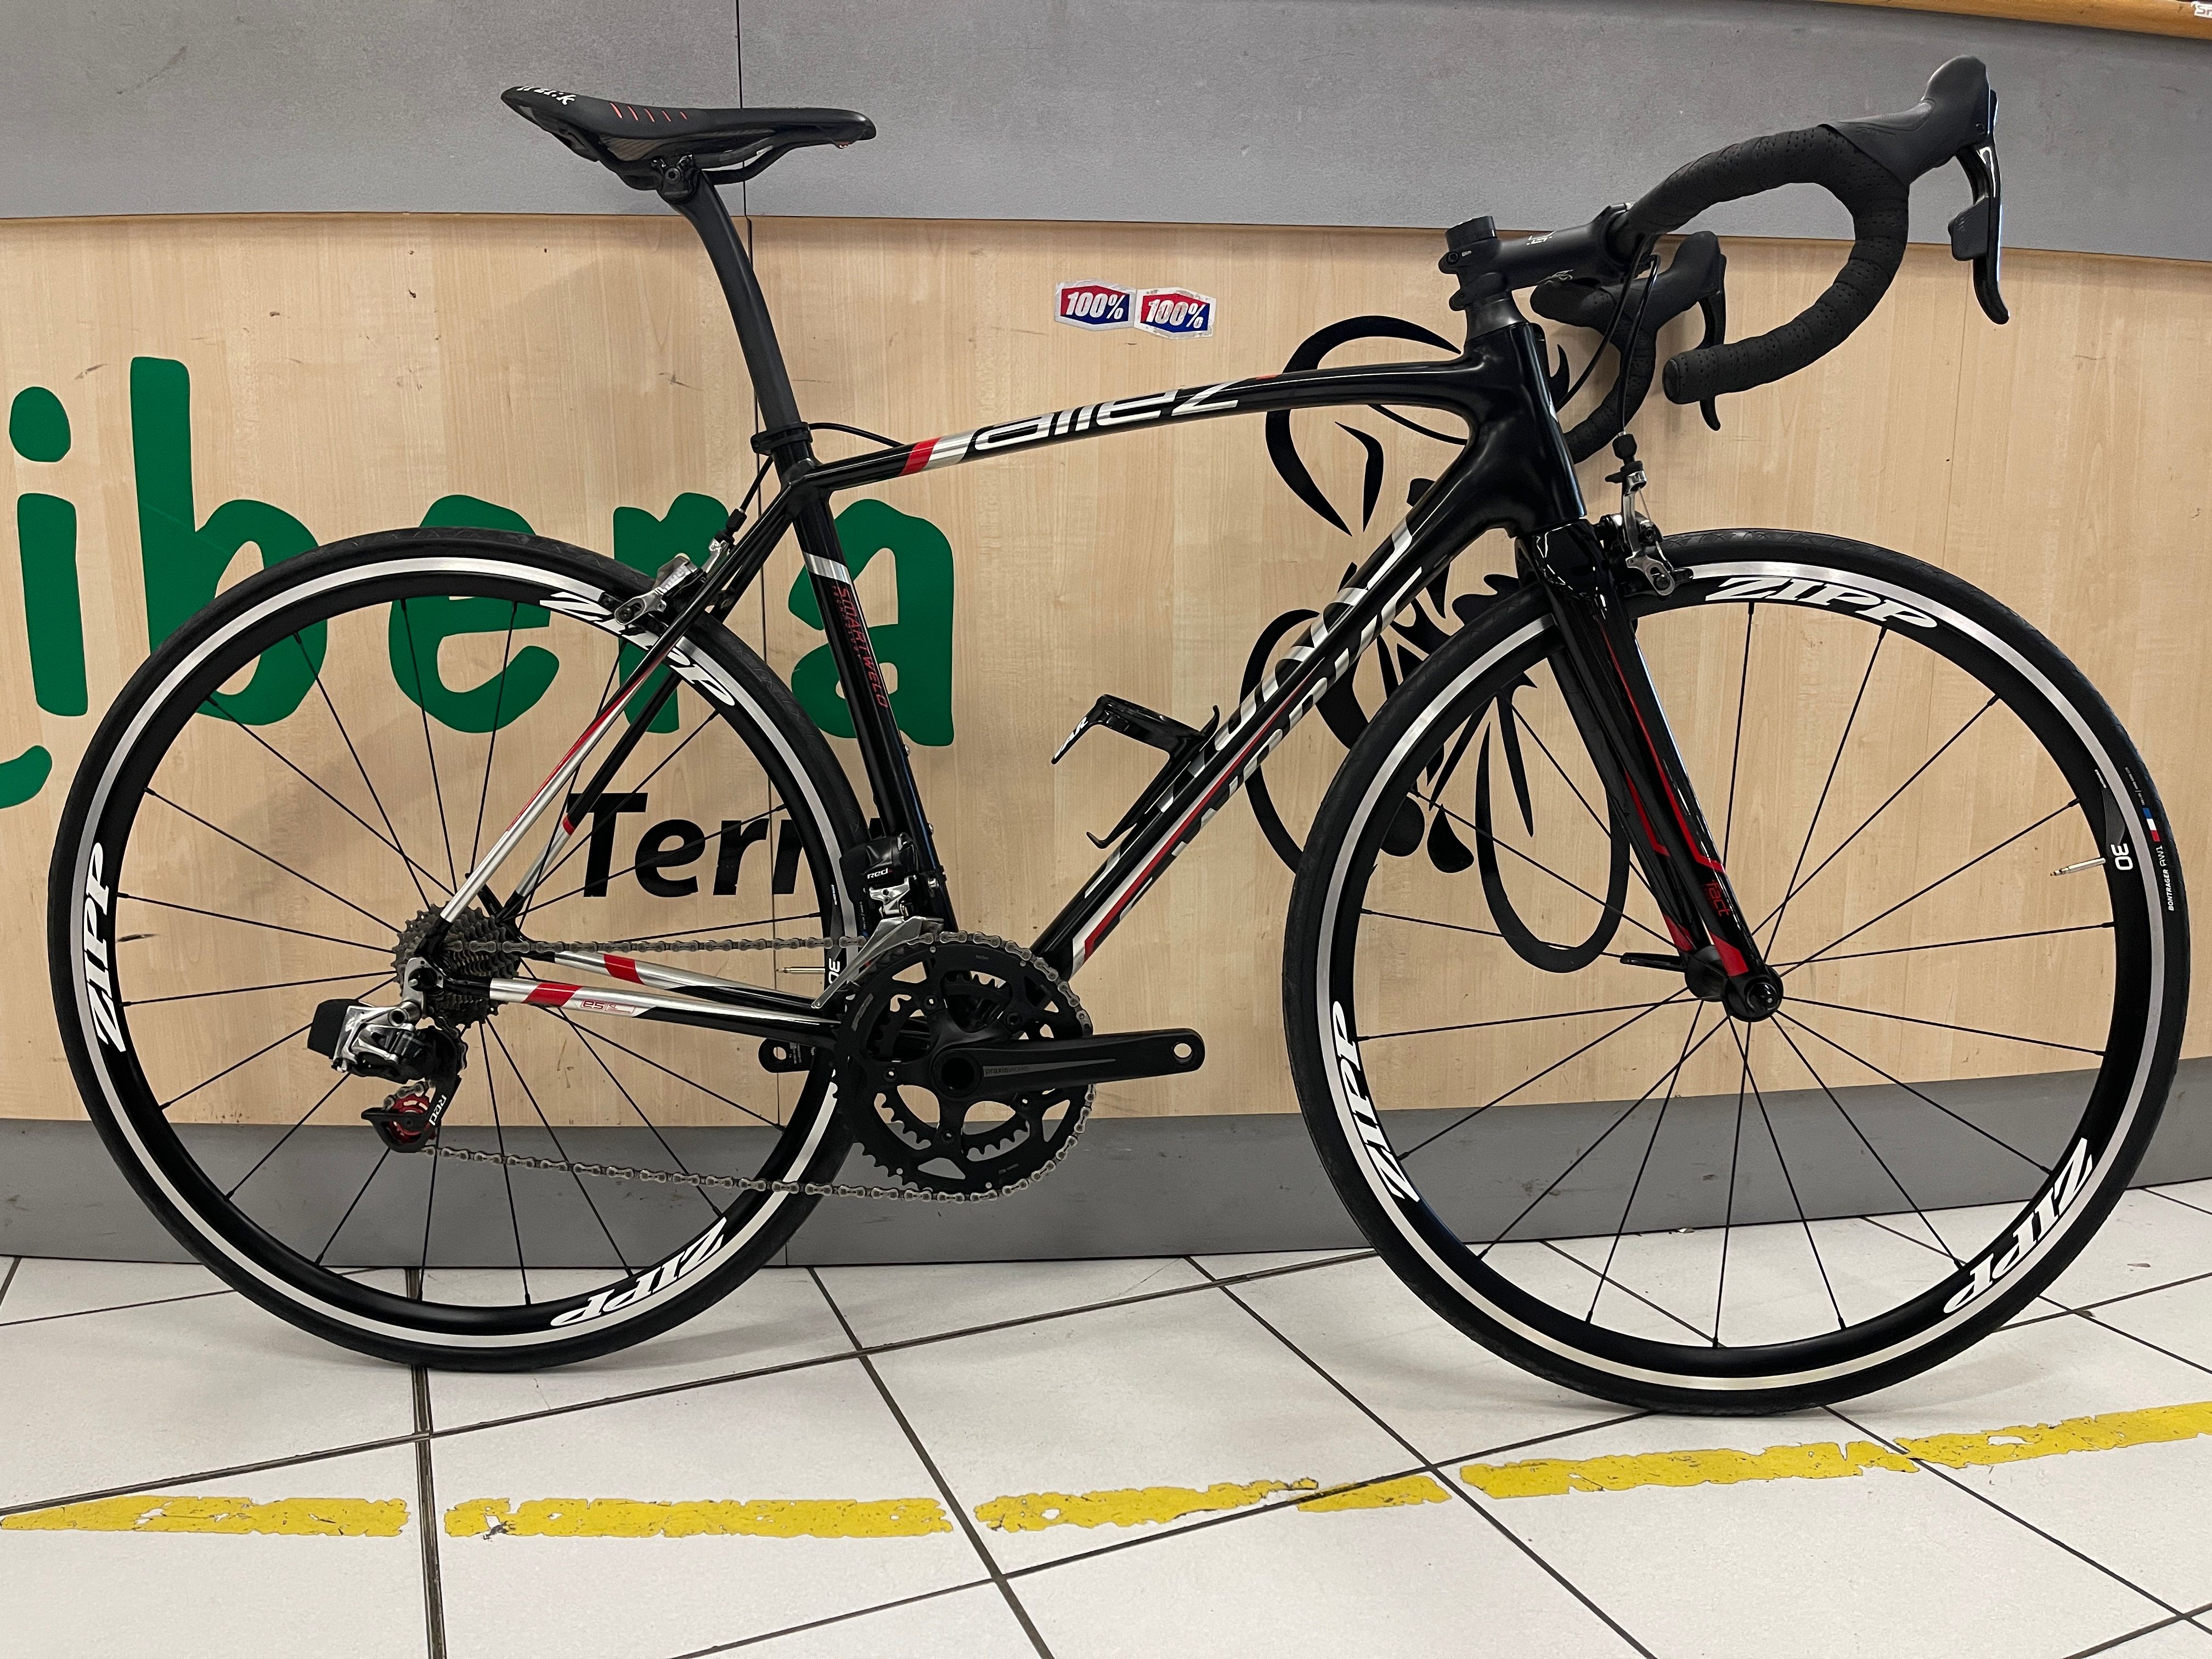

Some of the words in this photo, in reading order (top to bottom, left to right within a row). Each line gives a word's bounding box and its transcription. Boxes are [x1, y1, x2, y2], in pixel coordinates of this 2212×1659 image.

[1065, 291, 1125, 320] 100%
[1146, 299, 1206, 329] 100%
[974, 379, 1245, 450] allez
[0, 357, 955, 809] ibera
[1705, 577, 1937, 628] ZIPP
[2111, 843, 2133, 870] 30
[2164, 869, 2174, 911] BONTRAGER
[84, 842, 126, 1052] ZIPP
[1333, 1001, 1420, 1203] ZIPP
[1943, 1137, 2093, 1313] ZIPP
[550, 1217, 727, 1327] ZIPP
